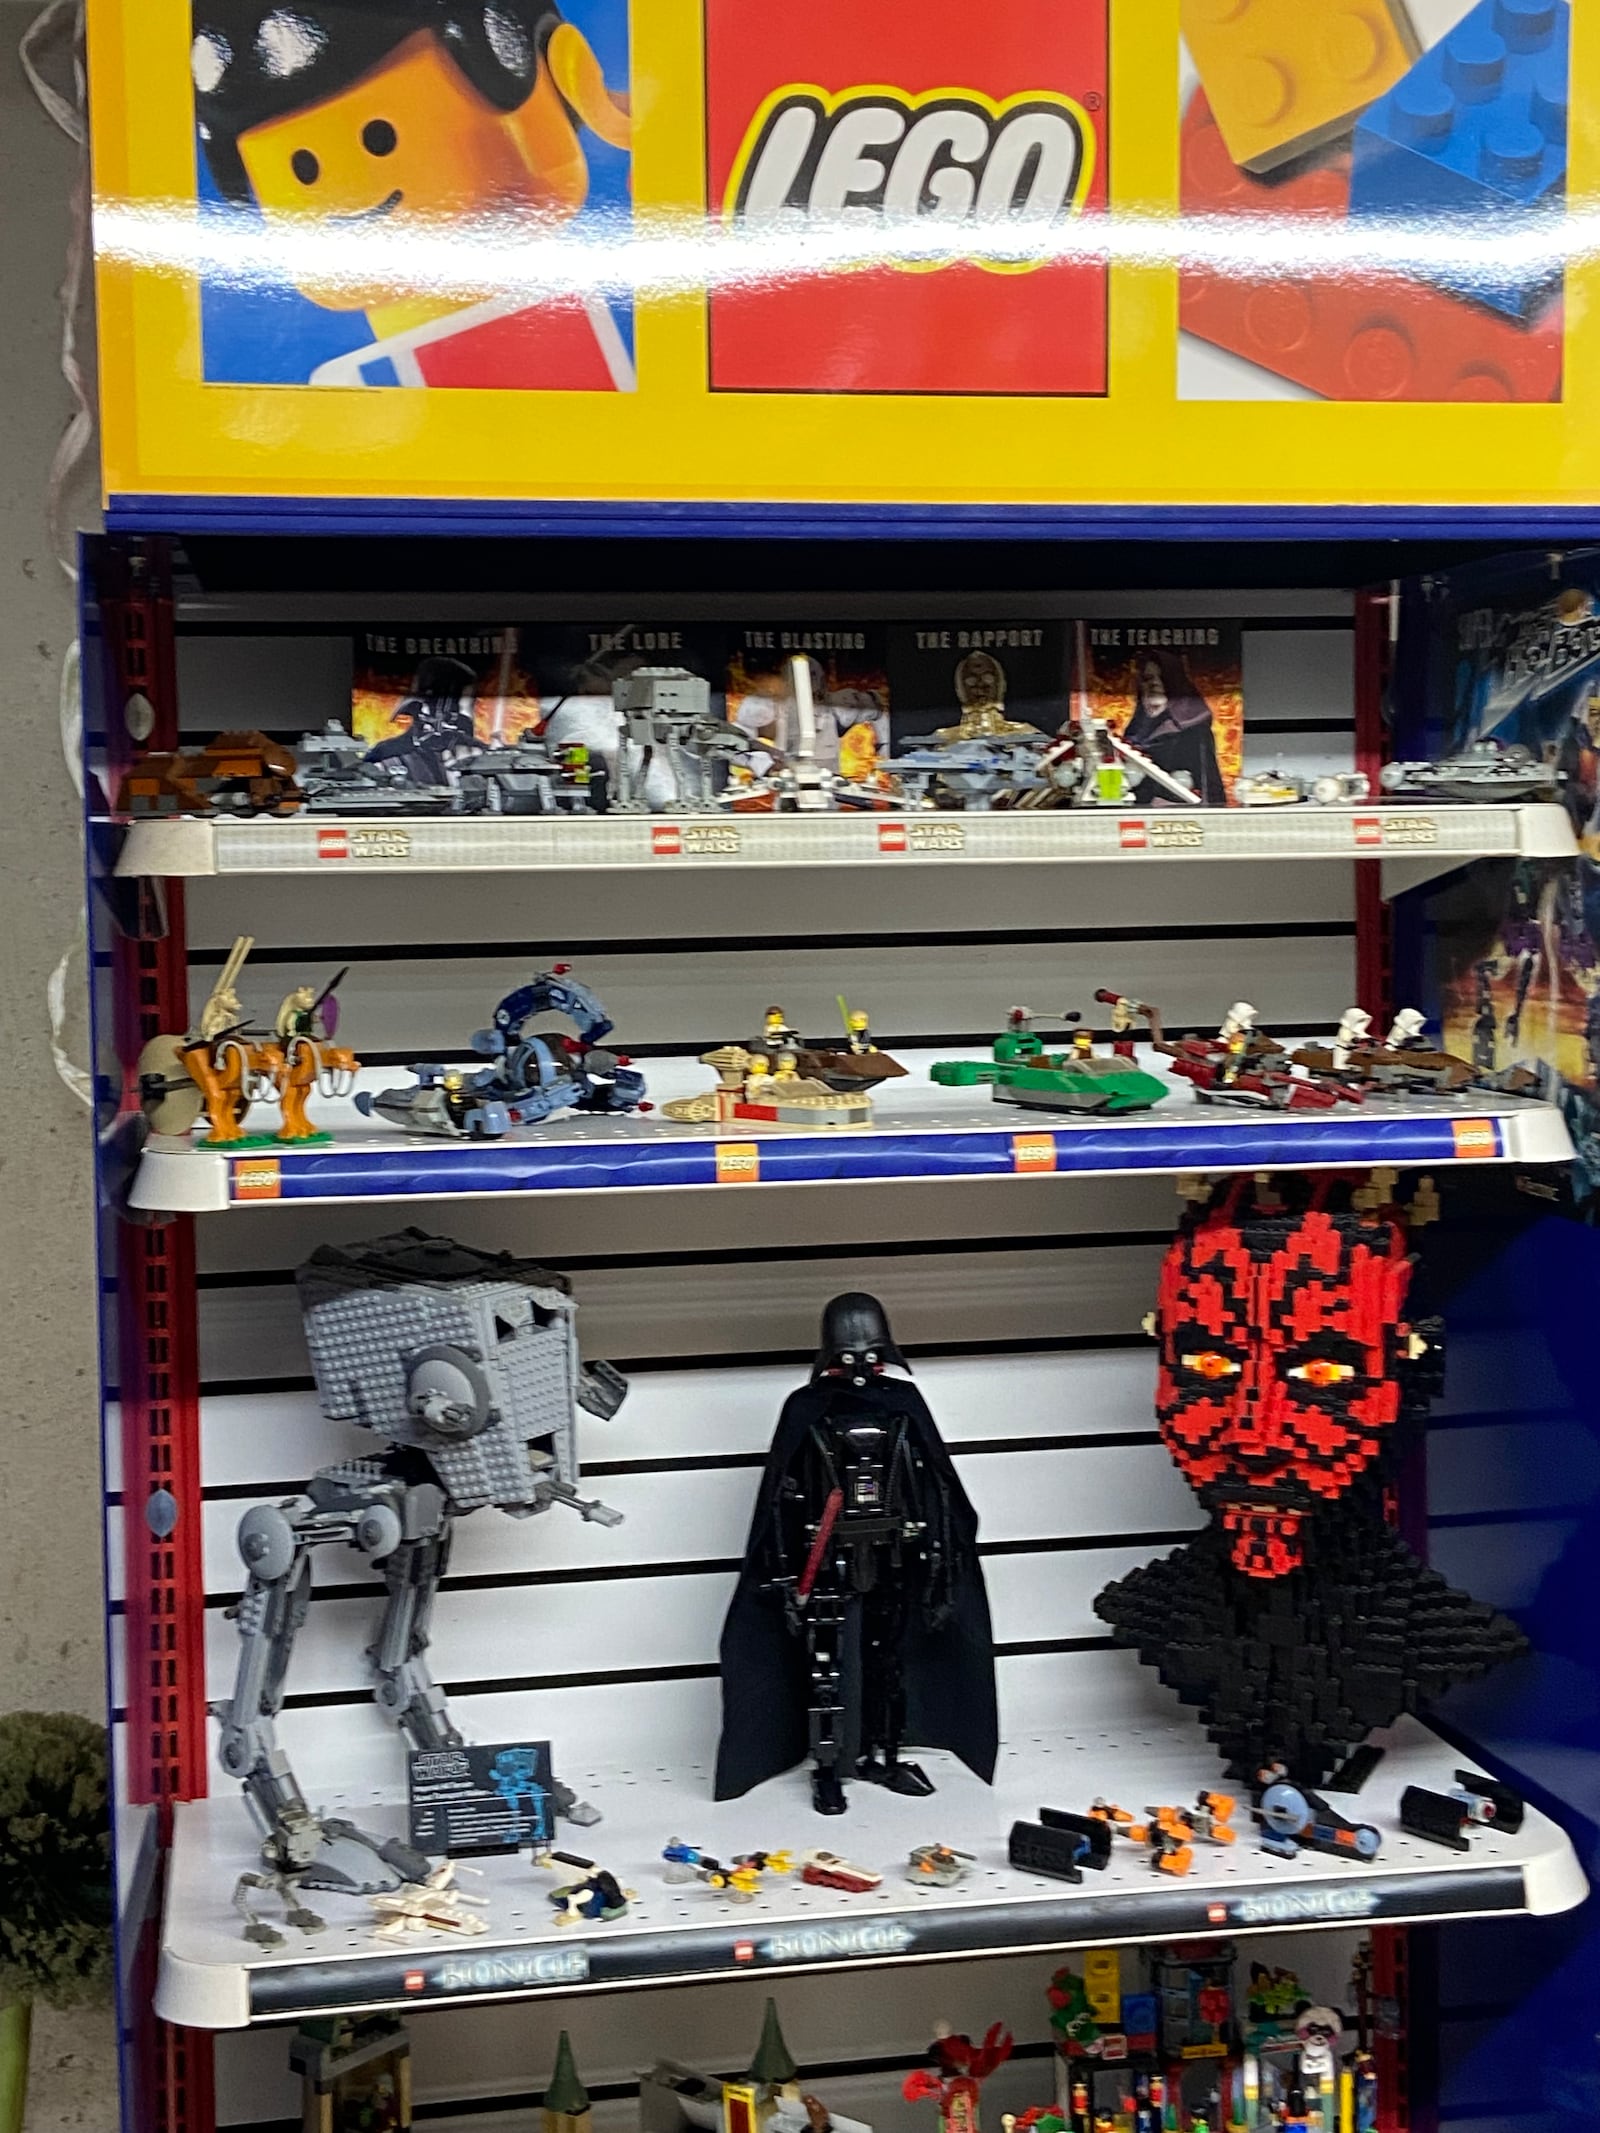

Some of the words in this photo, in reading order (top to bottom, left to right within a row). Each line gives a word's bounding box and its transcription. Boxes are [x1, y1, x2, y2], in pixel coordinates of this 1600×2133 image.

[736, 97, 1082, 252] LEGO
[366, 633, 398, 653] THE
[588, 633, 626, 651] THE
[632, 632, 682, 650] LORE
[744, 631, 776, 649] THE
[780, 632, 865, 649] BLASTING
[915, 631, 951, 649] THE
[957, 629, 1043, 648] RAPPORT
[1090, 628, 1121, 646] THE
[1126, 628, 1219, 646] TEACHING
